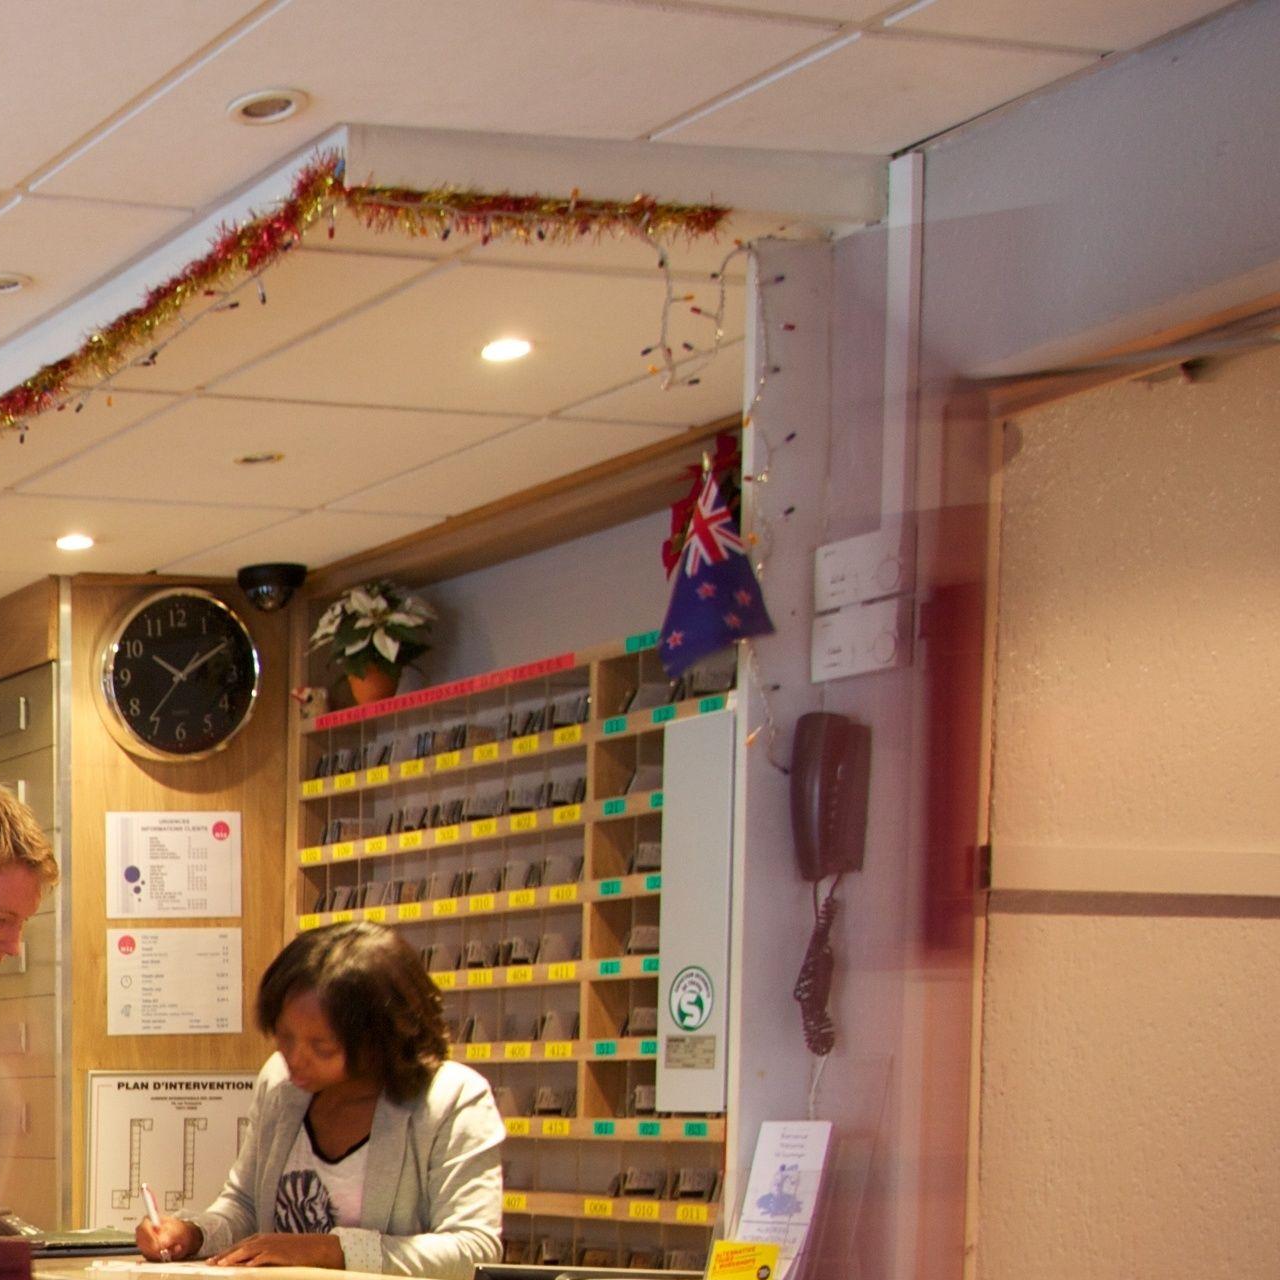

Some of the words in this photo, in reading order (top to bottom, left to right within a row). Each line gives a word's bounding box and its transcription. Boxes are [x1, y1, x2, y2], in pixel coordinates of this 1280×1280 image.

[169, 609, 187, 627] 12
[202, 617, 207, 634] 1
[147, 619, 162, 637] 11
[125, 640, 143, 659] 10
[120, 668, 131, 687] 9
[130, 698, 140, 716] 8
[219, 693, 229, 711] 4
[175, 721, 186, 740] 6
[203, 713, 212, 733] 5
[118, 1081, 149, 1090] PLAN
[153, 1081, 253, 1090] D'INTERVENTION
